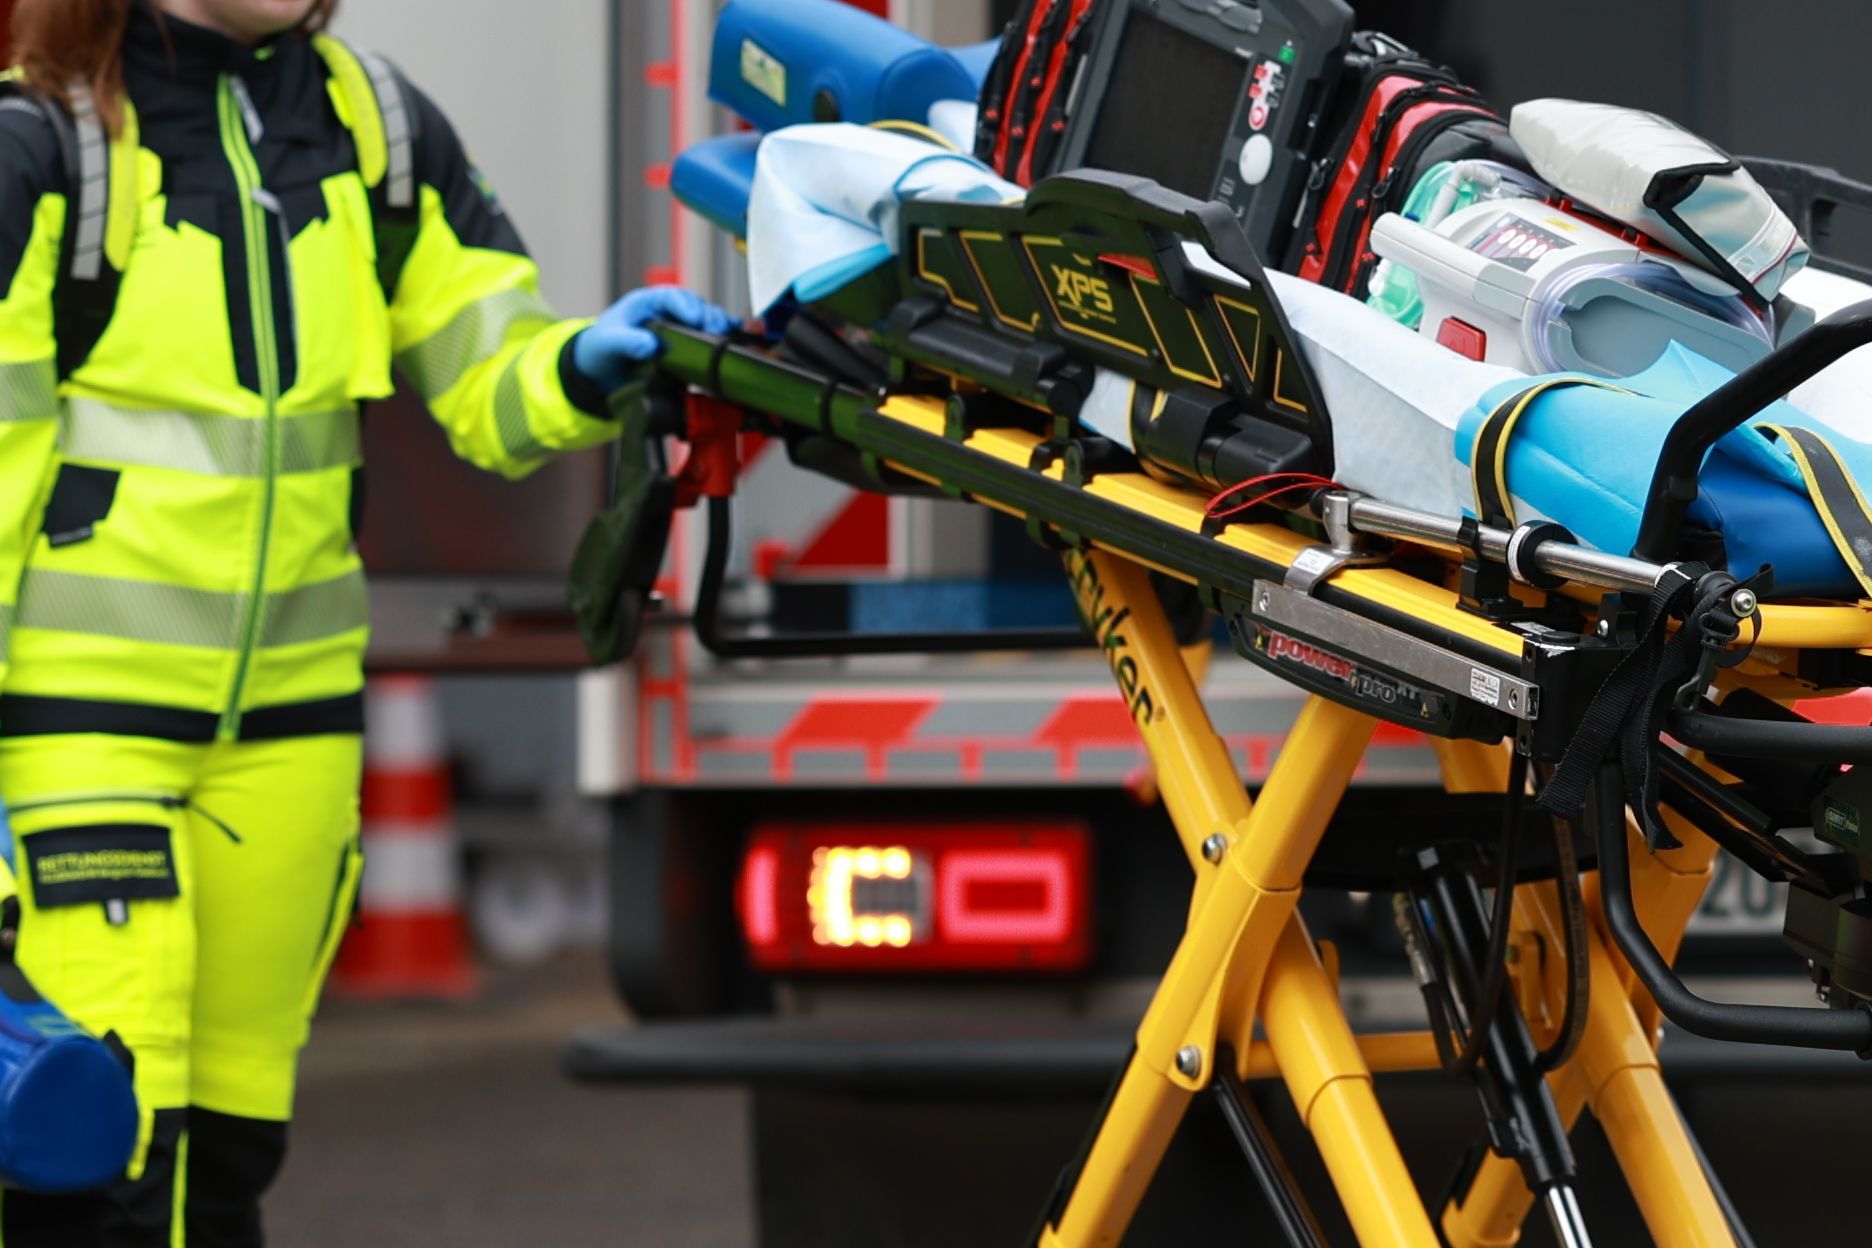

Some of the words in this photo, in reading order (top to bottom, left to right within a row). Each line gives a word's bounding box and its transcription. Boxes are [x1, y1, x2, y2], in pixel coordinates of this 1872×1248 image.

[1050, 263, 1115, 313] XPS
[1267, 632, 1354, 682] power
[1355, 668, 1397, 704] pro
